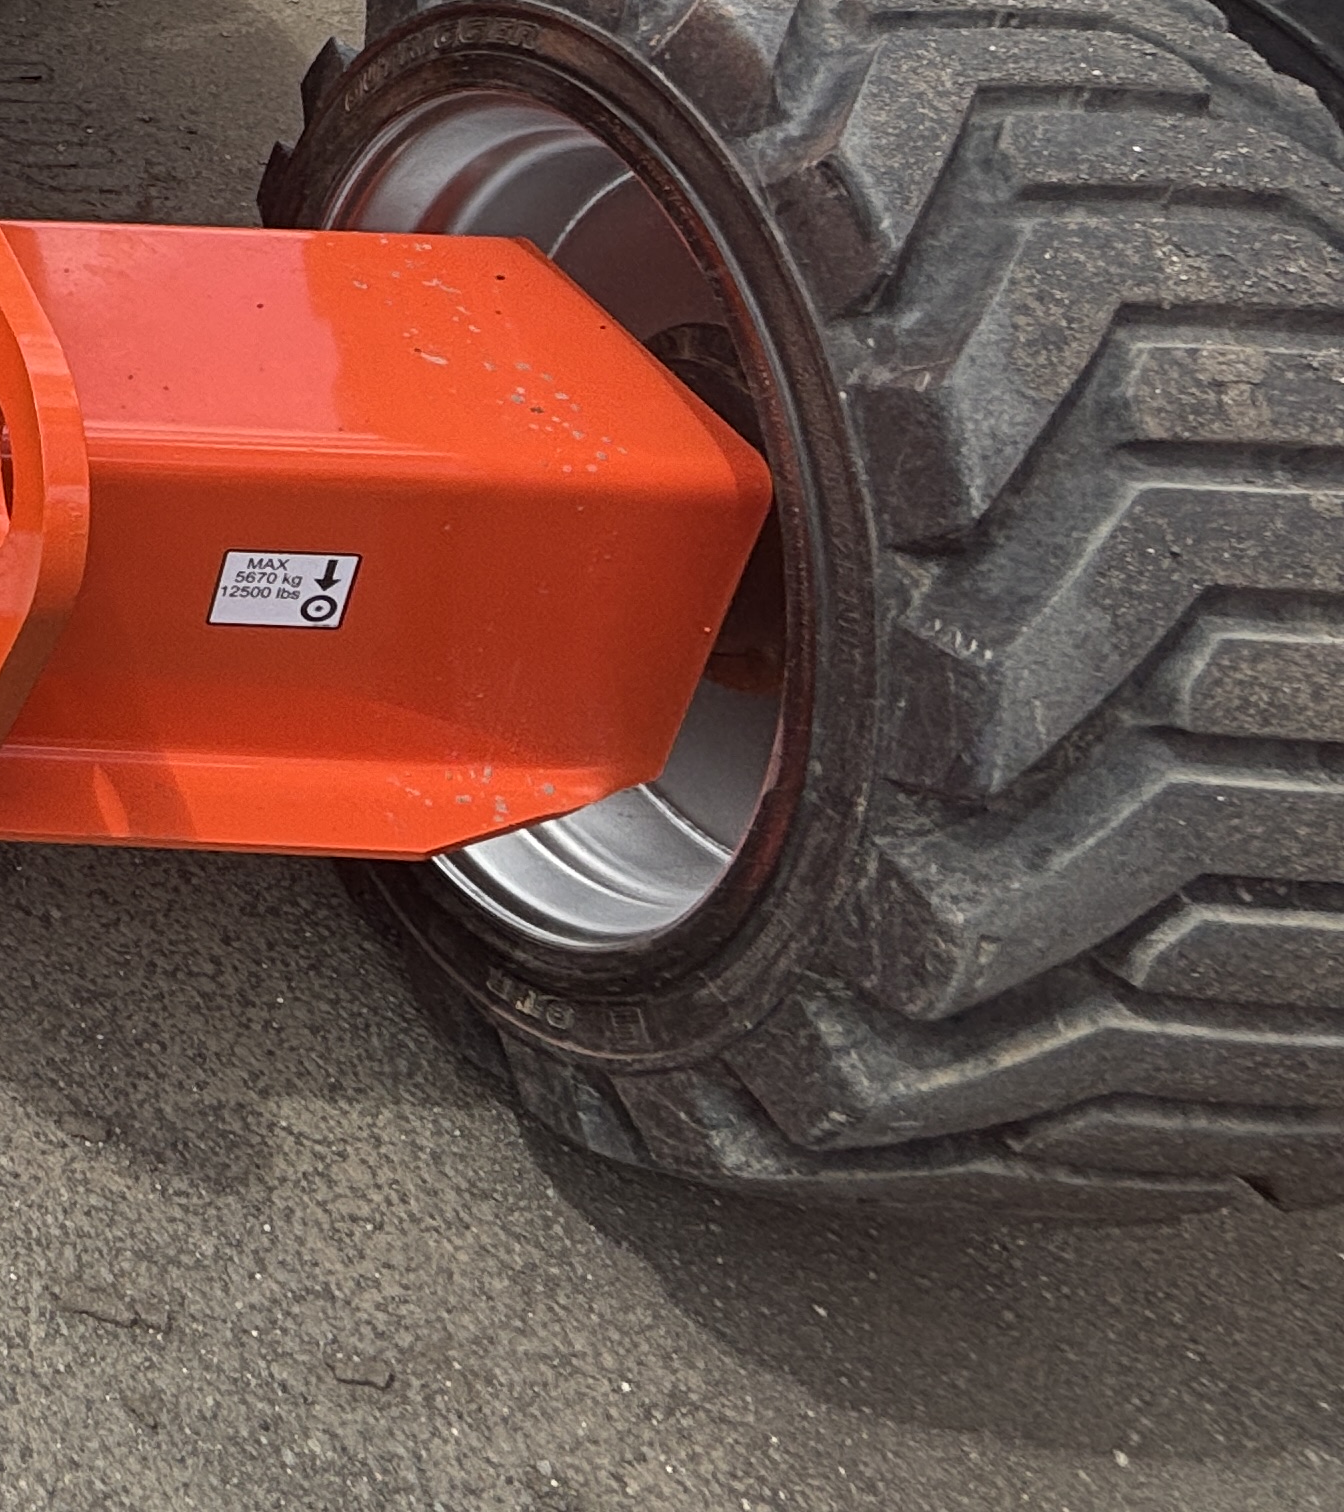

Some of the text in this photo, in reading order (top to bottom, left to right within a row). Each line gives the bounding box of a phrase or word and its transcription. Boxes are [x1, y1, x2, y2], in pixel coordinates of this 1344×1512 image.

[247, 558, 290, 571] MAX
[235, 571, 303, 588] 5670 kg
[221, 585, 301, 600] 12500 lbs
